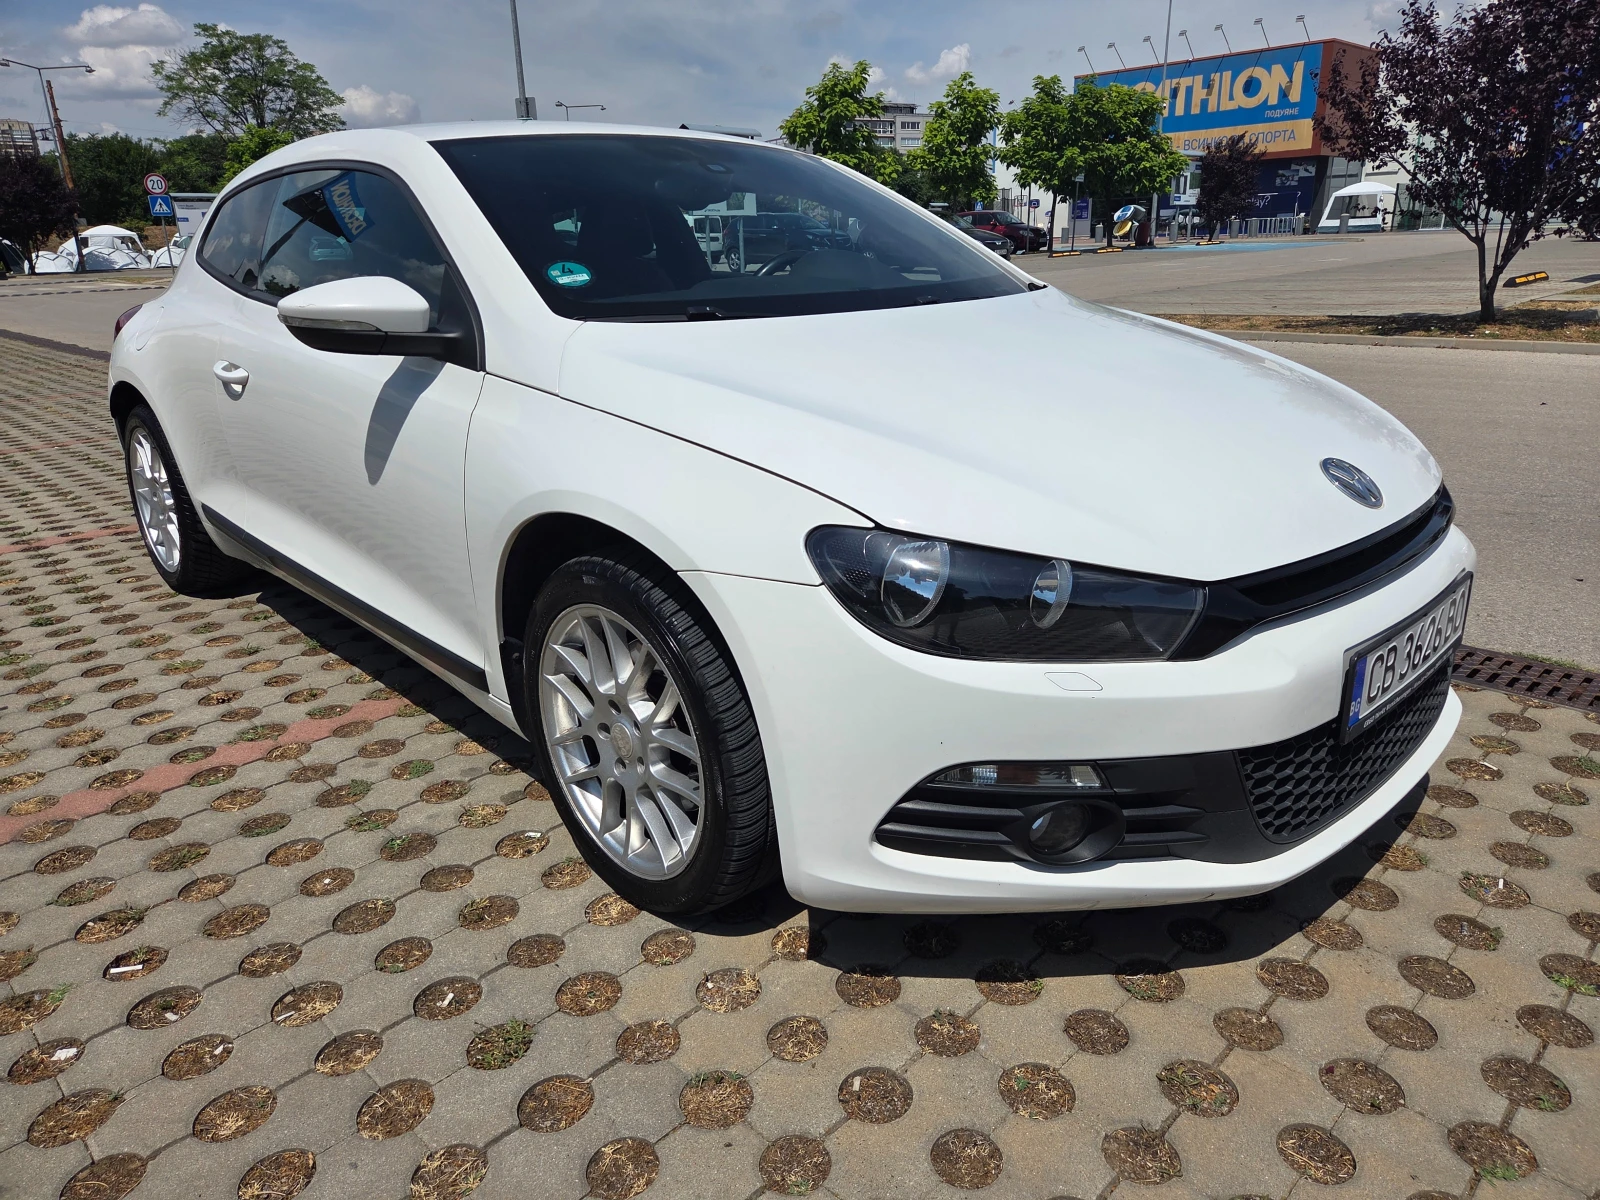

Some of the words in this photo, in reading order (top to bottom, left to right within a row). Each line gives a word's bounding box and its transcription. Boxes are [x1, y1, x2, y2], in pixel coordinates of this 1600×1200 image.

[1126, 61, 1304, 118] ATHLON
[1264, 107, 1300, 118] ПОДУЯНЕ
[1250, 129, 1296, 147] СПОРТА
[149, 179, 163, 190] 20
[1398, 605, 1445, 682] 3626
[1350, 697, 1361, 716] BG
